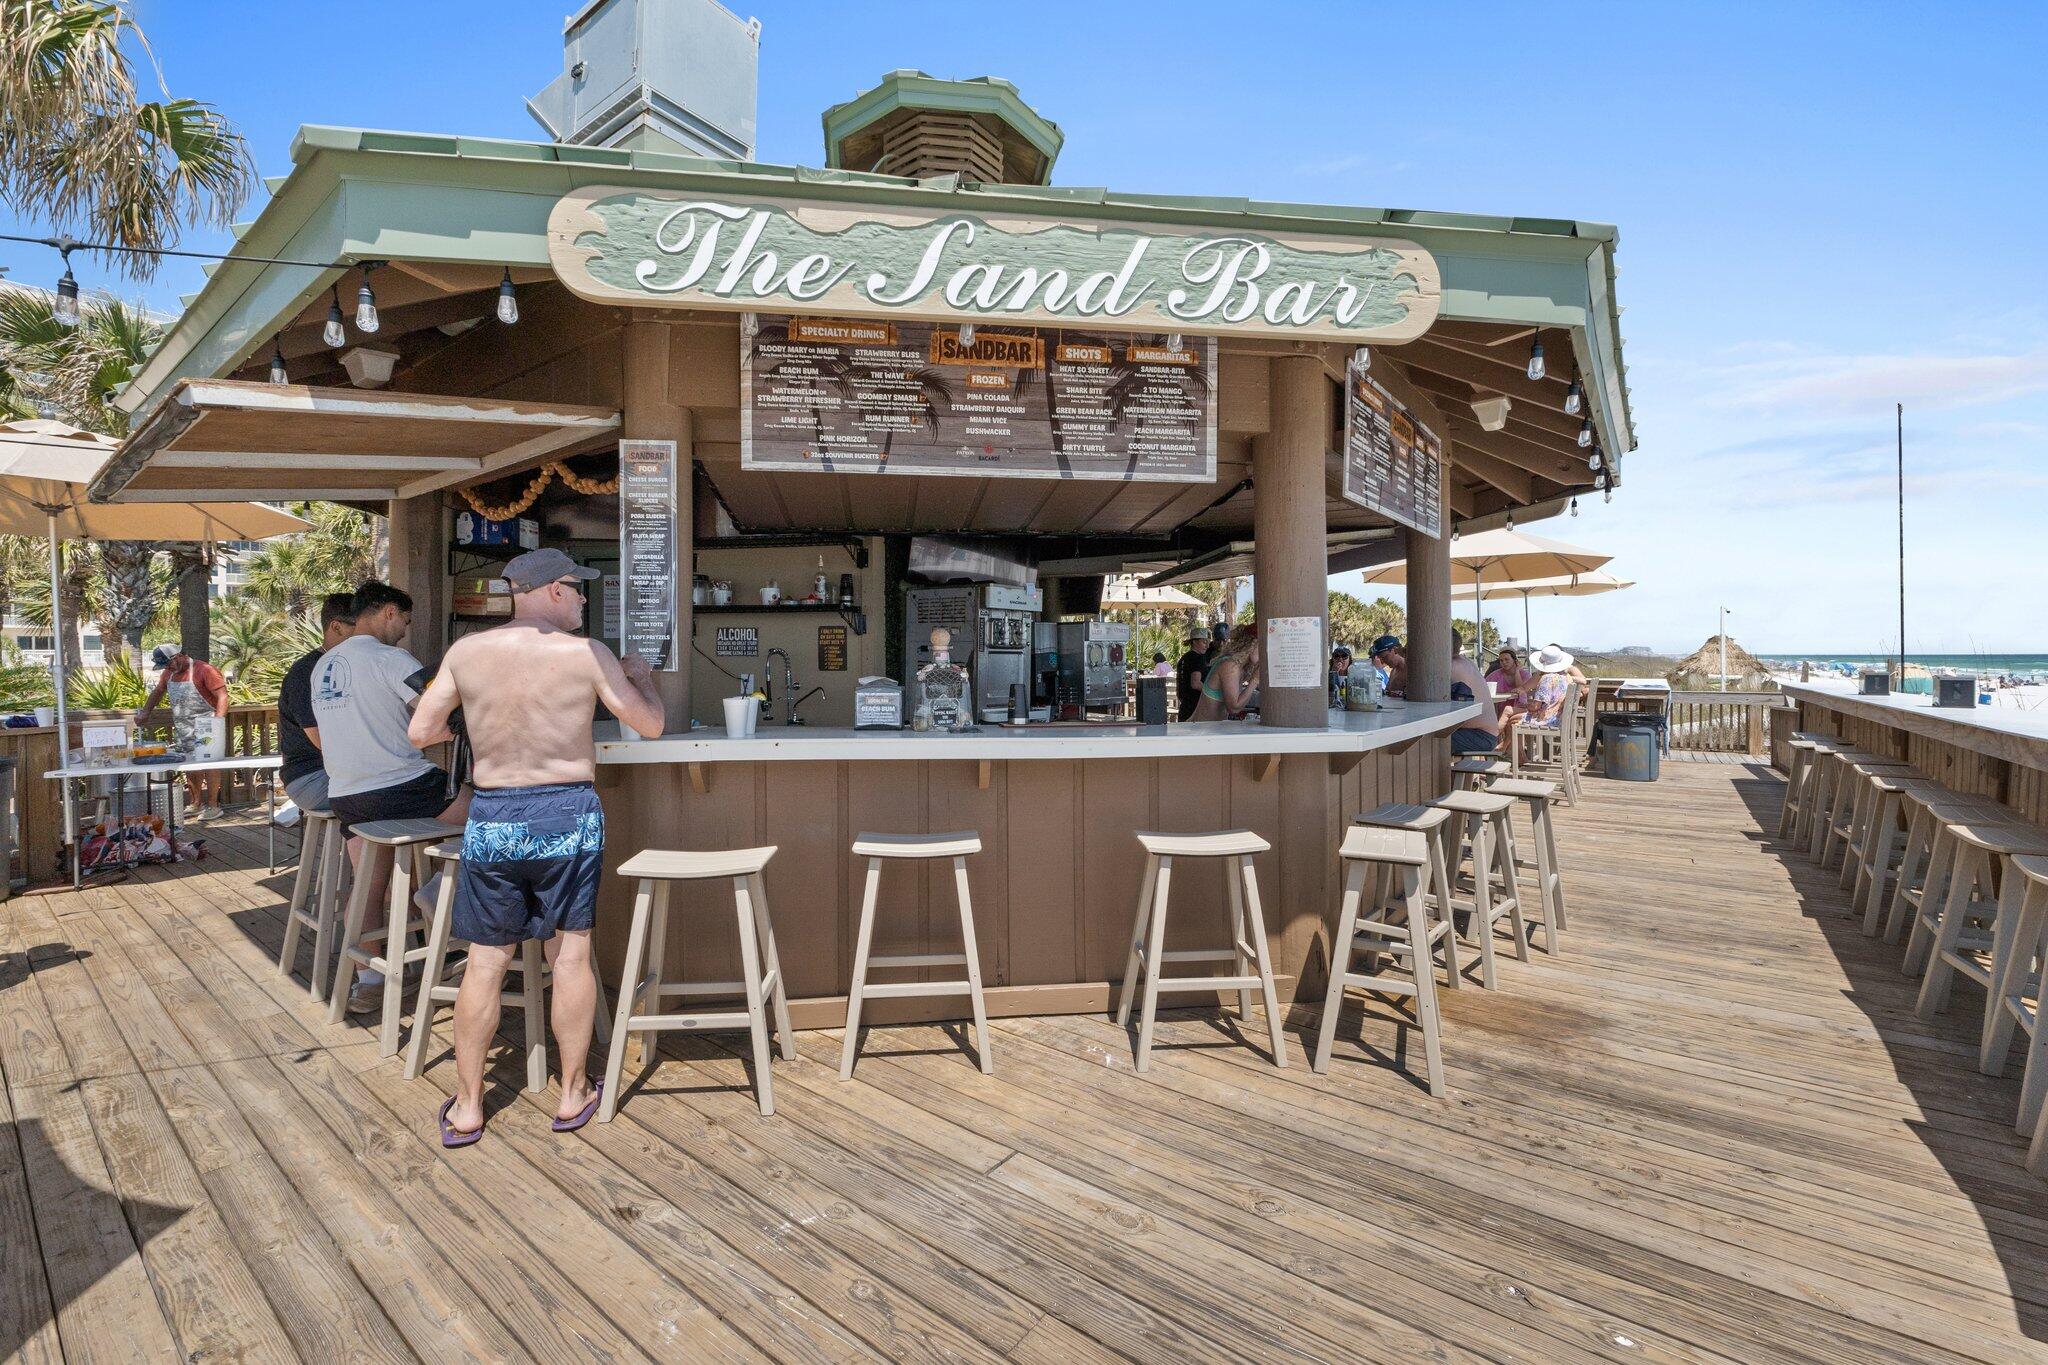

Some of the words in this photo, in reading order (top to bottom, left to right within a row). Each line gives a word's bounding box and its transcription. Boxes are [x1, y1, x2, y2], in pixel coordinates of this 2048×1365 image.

[635, 202, 856, 298] The
[866, 219, 1155, 315] Sand
[1167, 237, 1374, 325] Bar
[801, 326, 850, 337] SPECIALTY
[851, 329, 886, 339] DRINKS
[759, 344, 786, 352] BLOODY
[816, 347, 840, 355] MARIA
[855, 348, 900, 358] STRAWBERRY
[901, 351, 920, 359] BLISS
[943, 338, 1032, 362] SANDBAR
[1065, 348, 1102, 360] SHOTS
[1135, 351, 1190, 362] MARGARITAS
[1060, 365, 1076, 373] HEAT
[1087, 366, 1110, 374] SWEET
[1140, 366, 1186, 375] SANDBAR-RITA
[884, 372, 905, 380] WAVE
[971, 375, 1005, 386] FROZEN
[772, 388, 820, 396] WATERMELON
[1066, 386, 1088, 394] SHARK
[1088, 387, 1103, 395] BITE
[1158, 387, 1182, 395] MANGO
[757, 394, 803, 403] STRAWBERRY
[804, 396, 842, 404] REFRESHER
[857, 392, 892, 400] GOOMBAY
[893, 394, 918, 402] SMASH
[984, 394, 1010, 402] COLADA
[951, 404, 995, 412] STRAWBERRY
[996, 406, 1026, 414] DAIQUIRI
[1056, 406, 1078, 414] GREEN
[1079, 408, 1094, 416] BEAN
[1096, 408, 1113, 416] BACK
[1122, 406, 1166, 415] WATERMELON
[1166, 408, 1202, 416] MARGARITA
[781, 416, 798, 424] LIME
[798, 416, 818, 424] LIGHT
[882, 415, 910, 423] RUNNER
[992, 416, 1008, 424] VICE
[966, 427, 1011, 436] BUSHWACKER
[1089, 424, 1106, 432] BEAR
[1134, 427, 1154, 435] PEACH
[1155, 428, 1191, 436] MARGARITA
[836, 435, 868, 444] HORIZON
[1128, 442, 1160, 450] COCONUT
[1160, 444, 1196, 452] MARGARITA
[630, 452, 665, 460] SANDBAR
[717, 628, 758, 641] ALCOHOL
